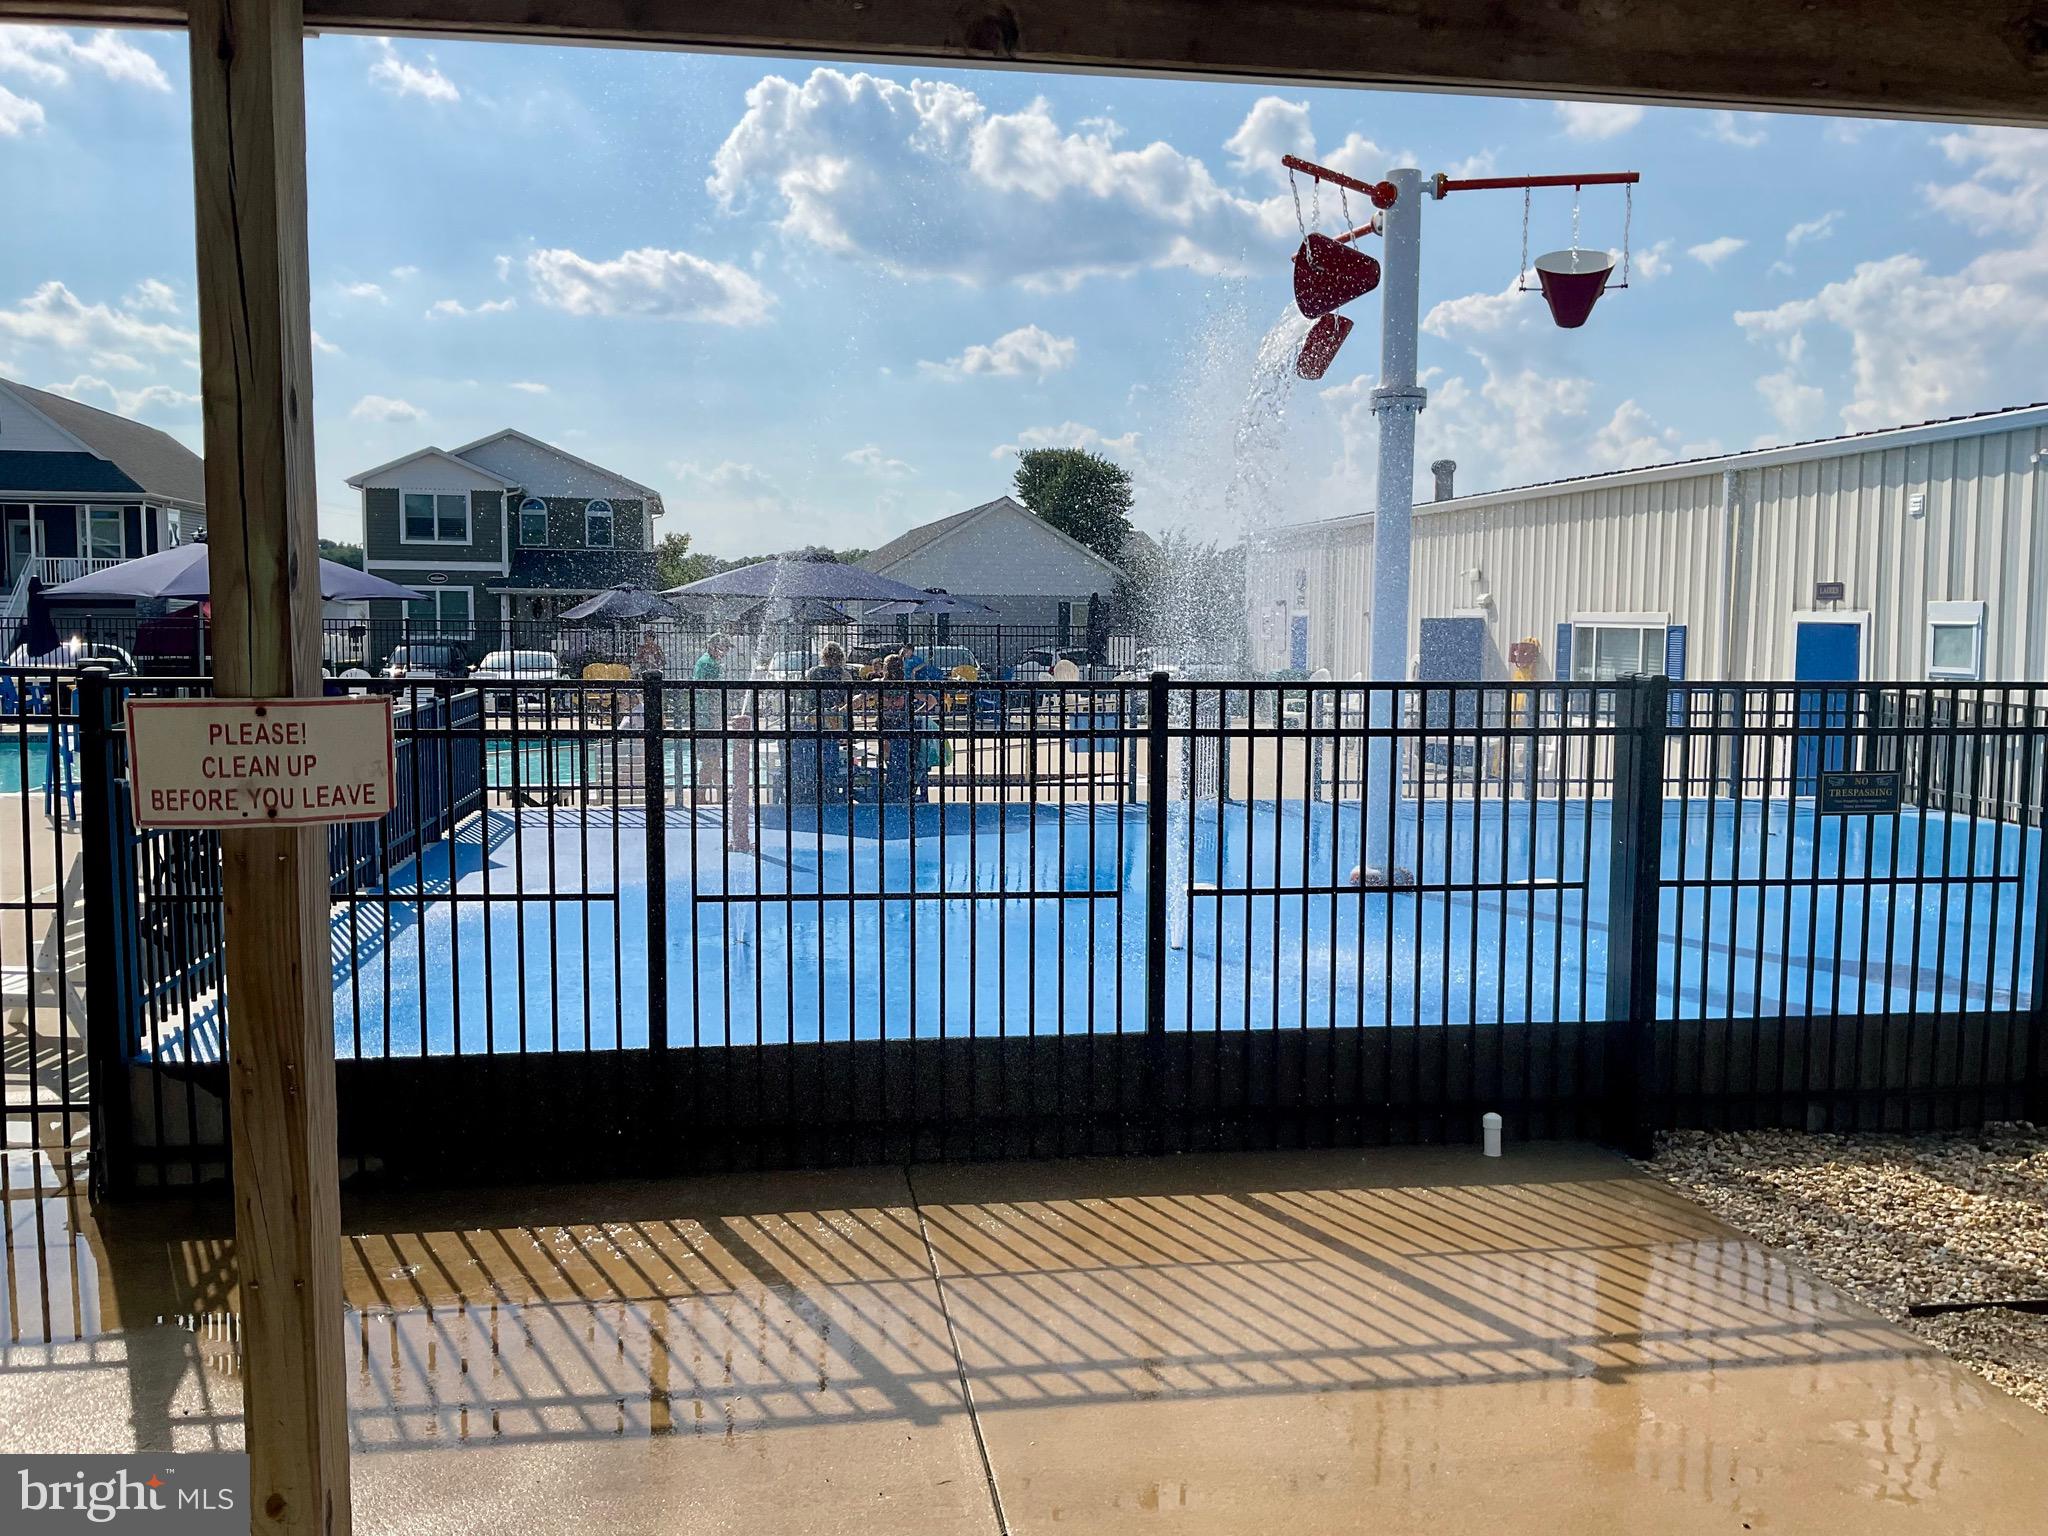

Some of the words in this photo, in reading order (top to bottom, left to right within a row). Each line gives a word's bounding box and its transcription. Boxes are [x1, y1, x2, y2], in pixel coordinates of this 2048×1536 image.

[208, 722, 307, 746] PLEASE!
[201, 755, 280, 779] CLEAN
[287, 754, 317, 777] UP
[1829, 788, 1893, 797] TRESPASSING
[1854, 776, 1869, 786] NO
[151, 788, 239, 811] BEFORE
[246, 787, 294, 809] YOU
[303, 783, 376, 808] LEAVE
